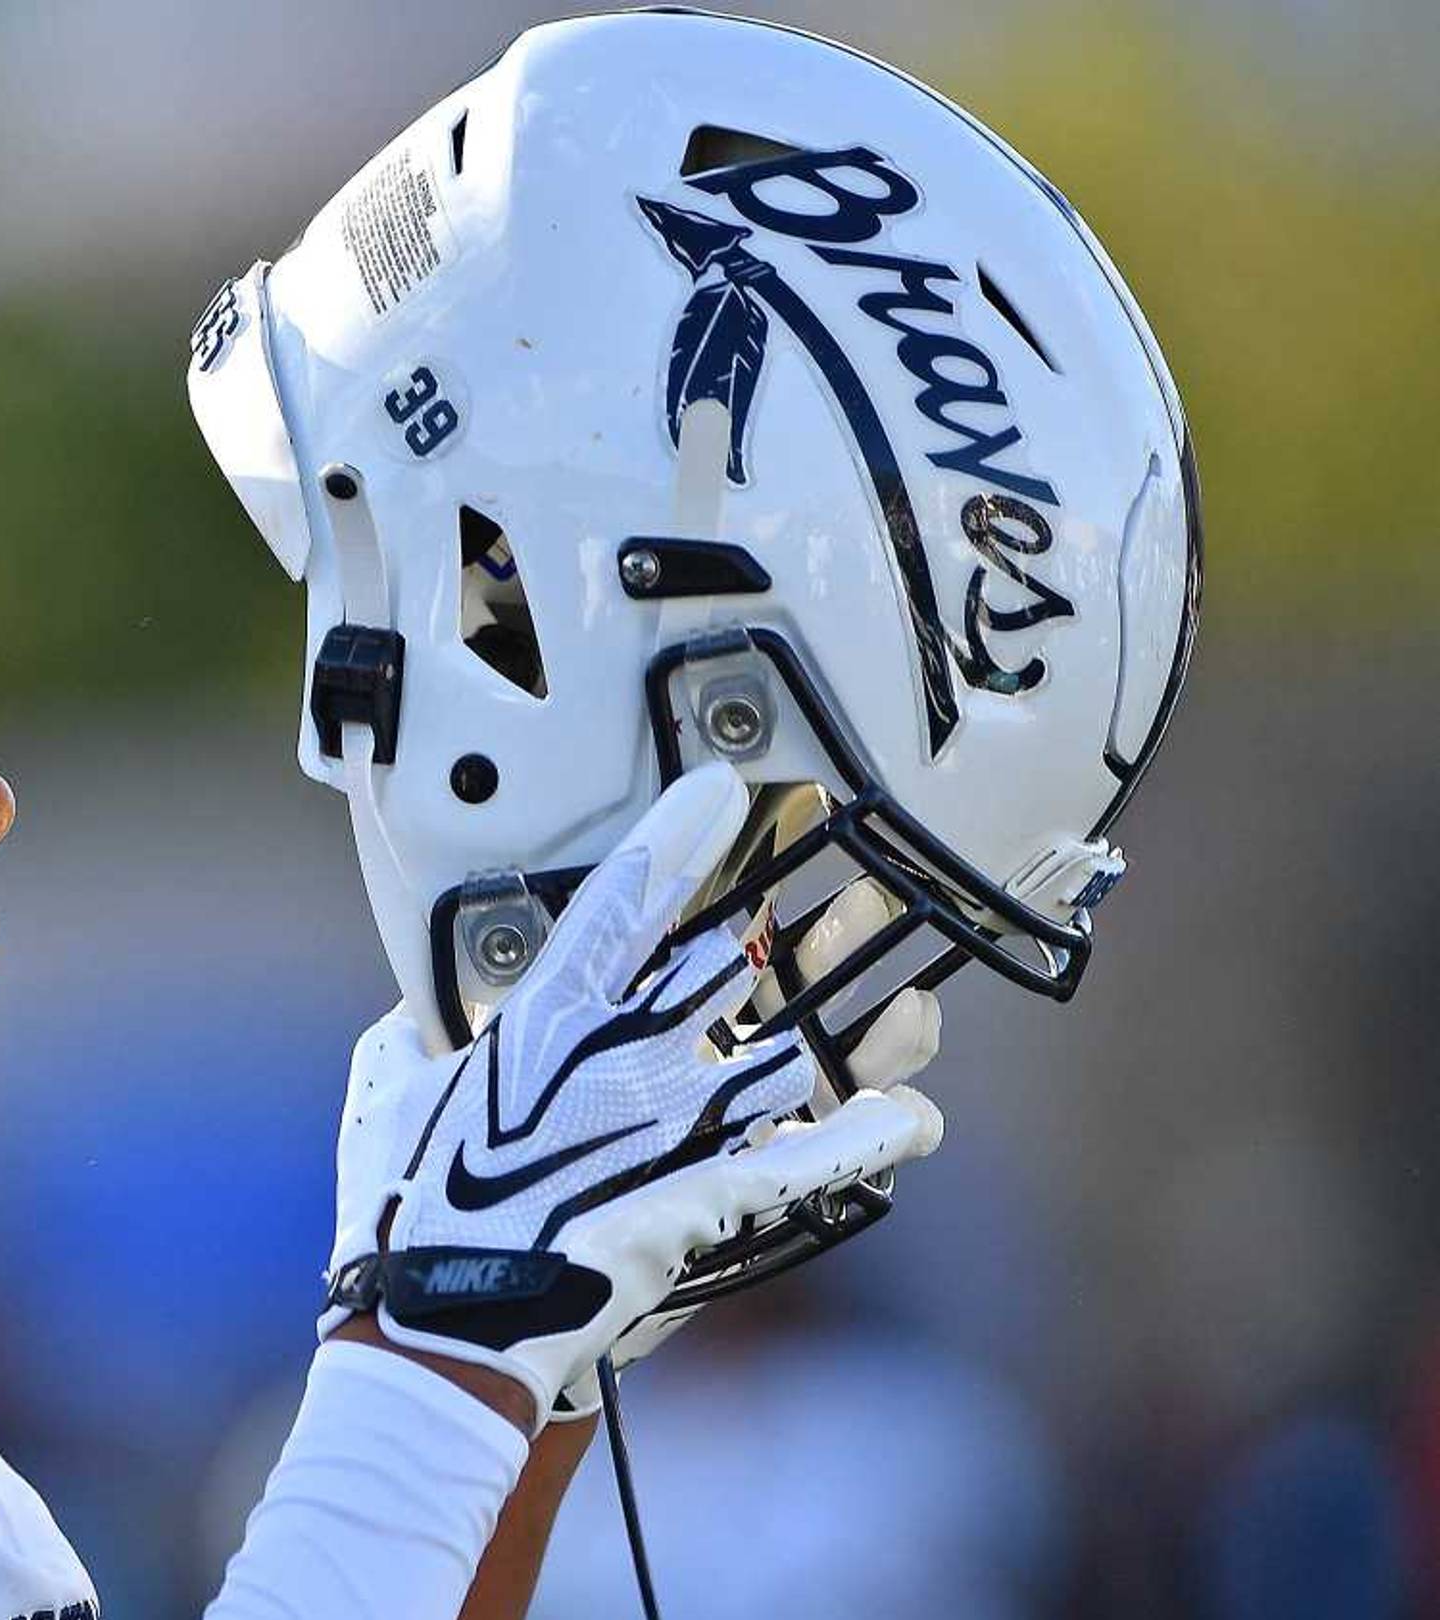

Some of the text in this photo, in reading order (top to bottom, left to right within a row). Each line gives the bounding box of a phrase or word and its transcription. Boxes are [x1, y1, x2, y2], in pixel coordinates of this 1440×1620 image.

[384, 366, 458, 456] 39
[682, 146, 1075, 694] Braves
[424, 1258, 511, 1294] NIKE
